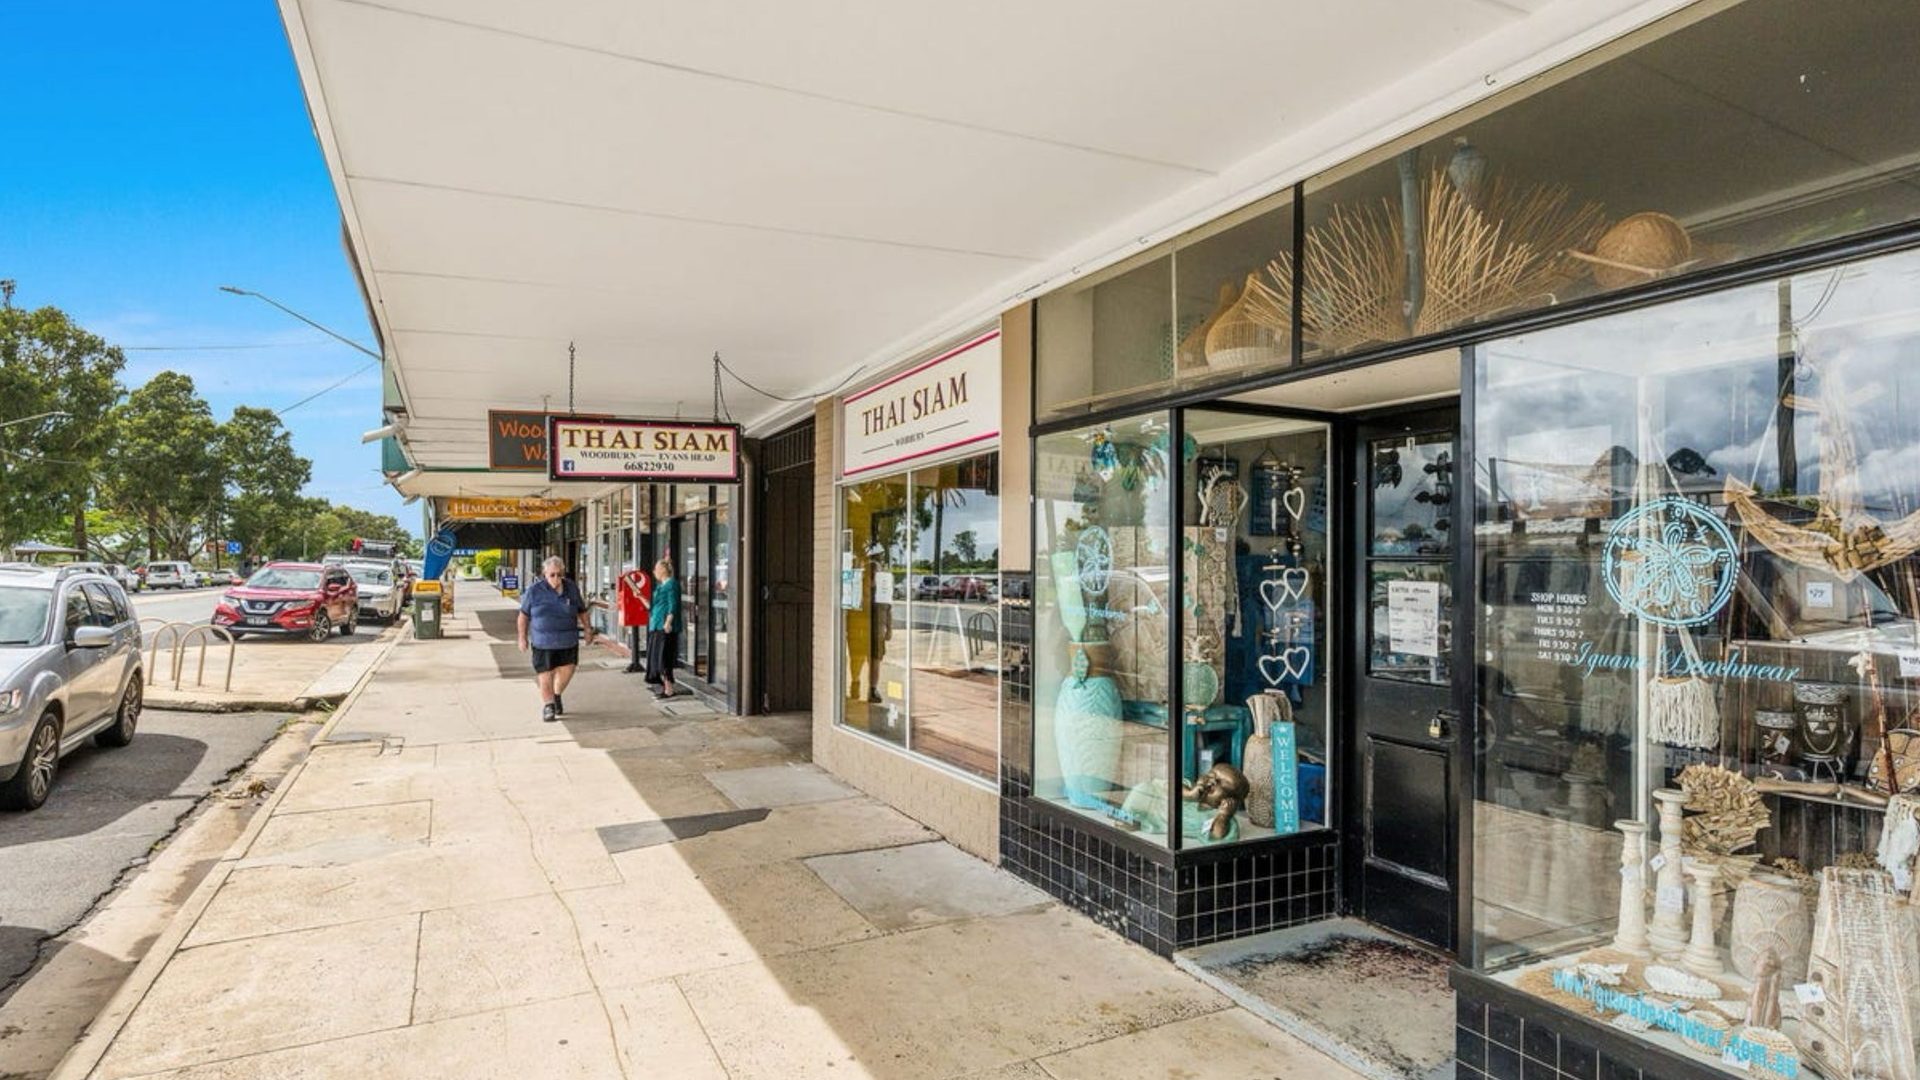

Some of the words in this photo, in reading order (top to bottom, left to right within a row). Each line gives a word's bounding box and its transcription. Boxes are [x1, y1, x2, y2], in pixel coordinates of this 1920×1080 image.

[862, 396, 907, 437] THAI
[913, 372, 968, 421] SIAM
[563, 428, 644, 449] THAI
[654, 431, 729, 451] SIAM
[580, 451, 636, 460] WOODBURN
[658, 453, 689, 462] EVANS
[690, 454, 716, 462] HEAD
[624, 461, 675, 472] 66822930
[1531, 592, 1555, 603] SHOP
[1556, 593, 1587, 605] HOURS
[1536, 604, 1554, 613] MON
[1278, 737, 1294, 823] WELCOME
